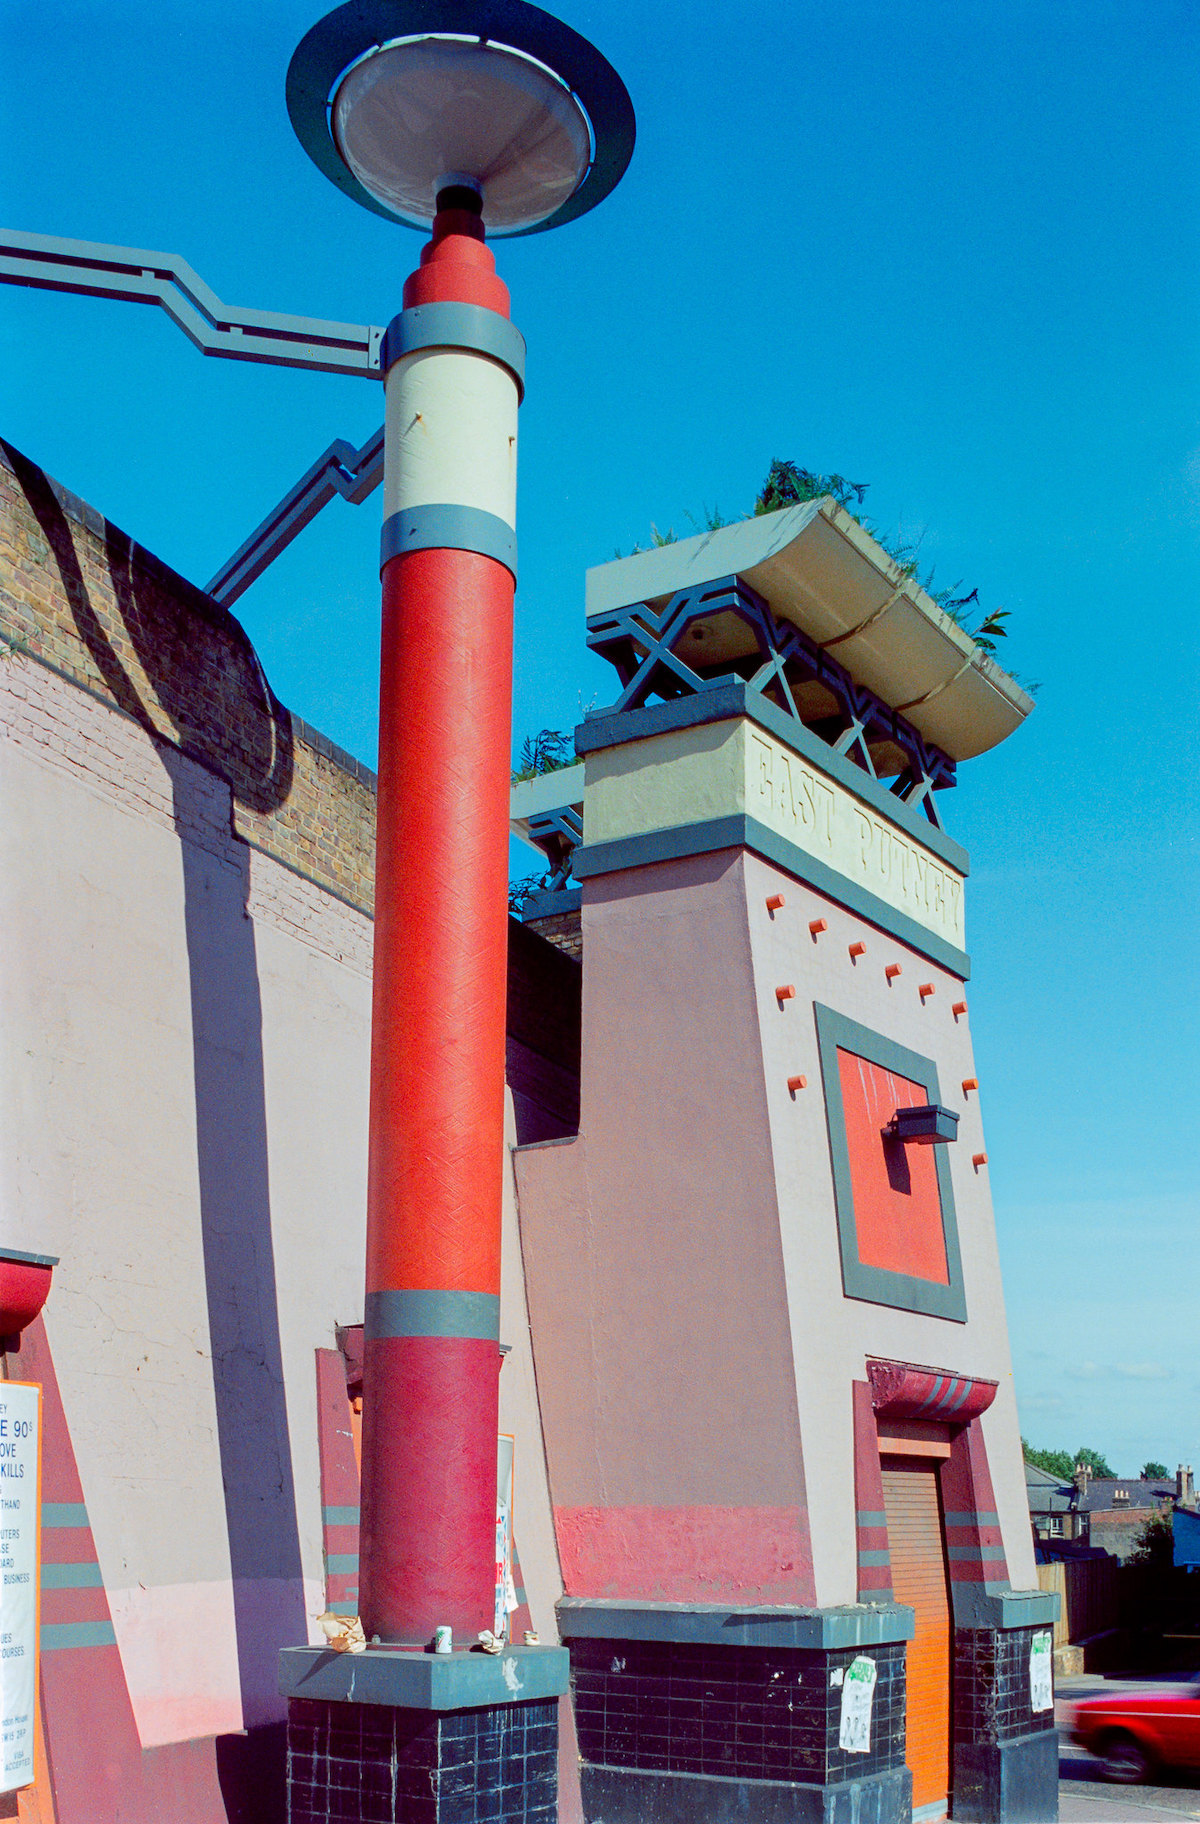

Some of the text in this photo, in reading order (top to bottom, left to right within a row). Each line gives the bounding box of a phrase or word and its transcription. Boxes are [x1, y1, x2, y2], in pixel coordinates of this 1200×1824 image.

[750, 734, 961, 932] EAST PUTNEY
[3, 1573, 30, 1585] BUSINESS
[4, 1757, 31, 1772] ACCEPTED
